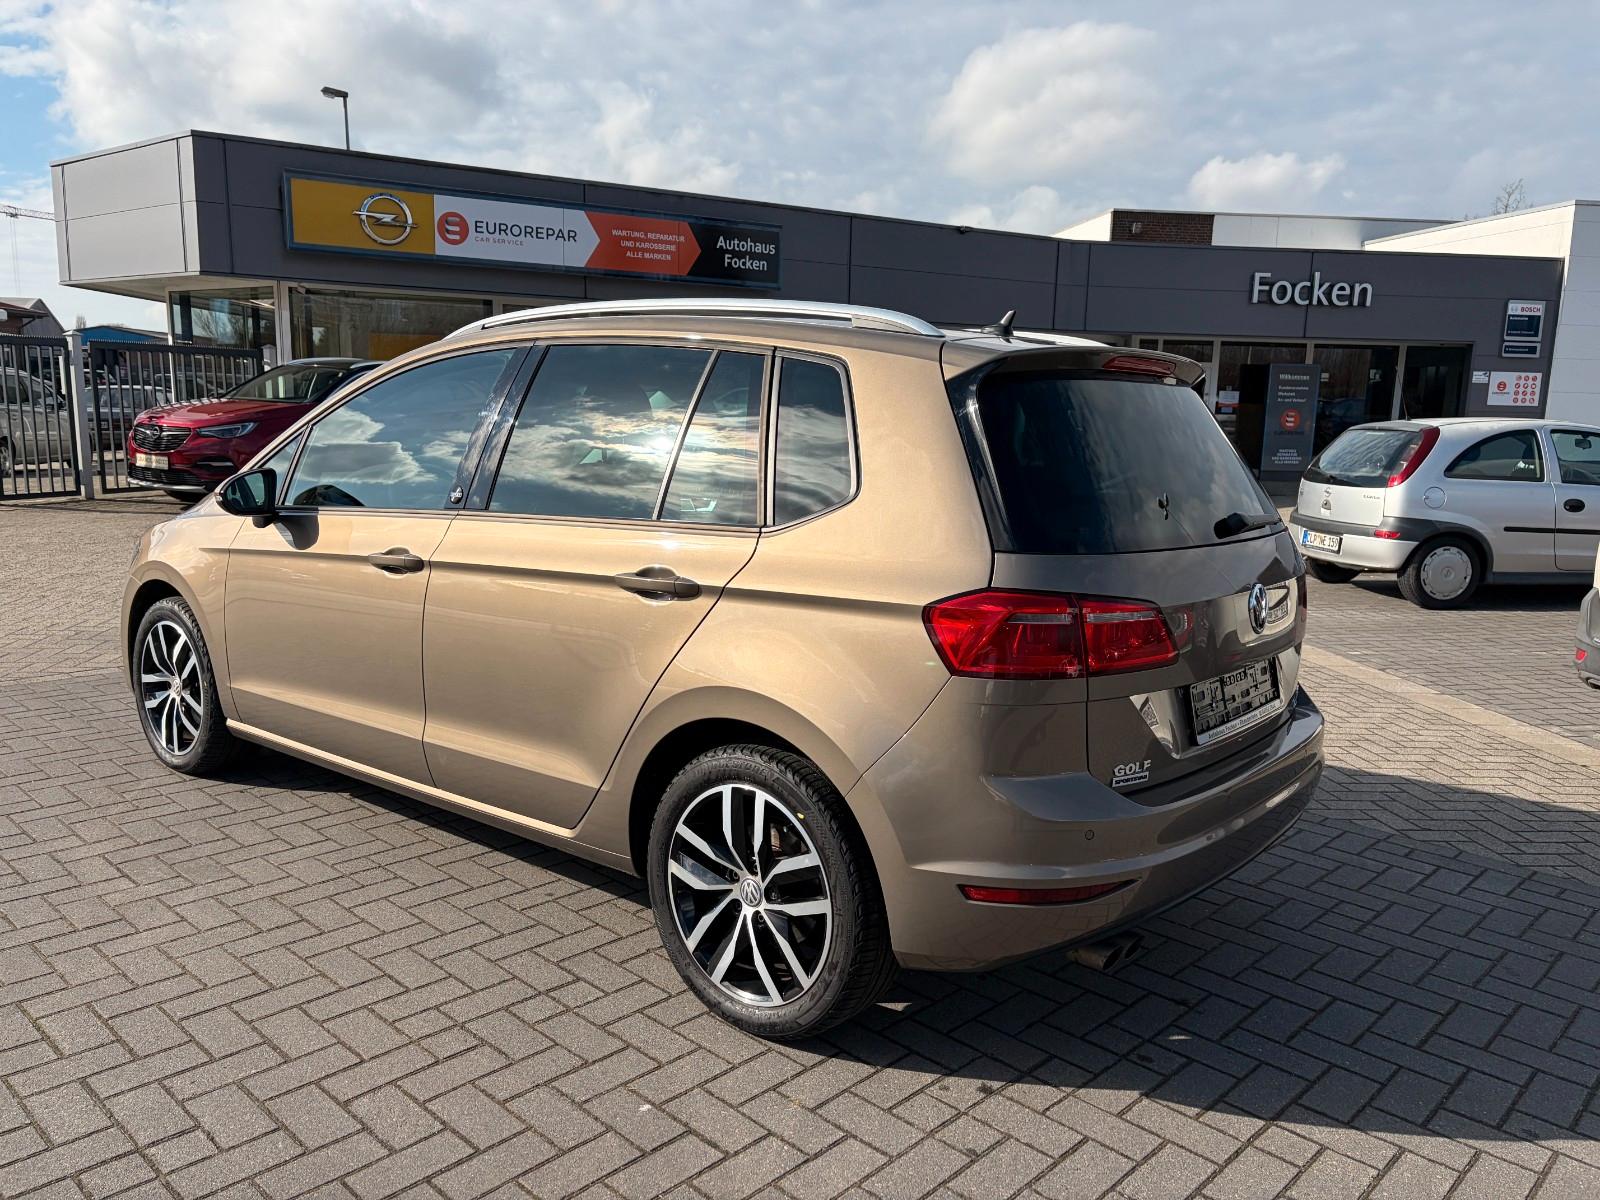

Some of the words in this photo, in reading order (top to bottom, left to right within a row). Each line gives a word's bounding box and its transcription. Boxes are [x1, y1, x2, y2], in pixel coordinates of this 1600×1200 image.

[474, 220, 578, 242] EUROREPAR
[612, 229, 646, 239] WARTUNG,
[647, 232, 685, 242] REPARATUR
[493, 238, 524, 246] SERVICE
[620, 240, 635, 248] UND
[635, 241, 677, 251] KAROSSERIE
[716, 235, 776, 255] Autohaus
[626, 250, 643, 259] ALLE
[724, 254, 768, 271] Focken
[1252, 271, 1373, 307] Focken
[1328, 536, 1339, 549] 159
[1114, 760, 1152, 777] GOLF
